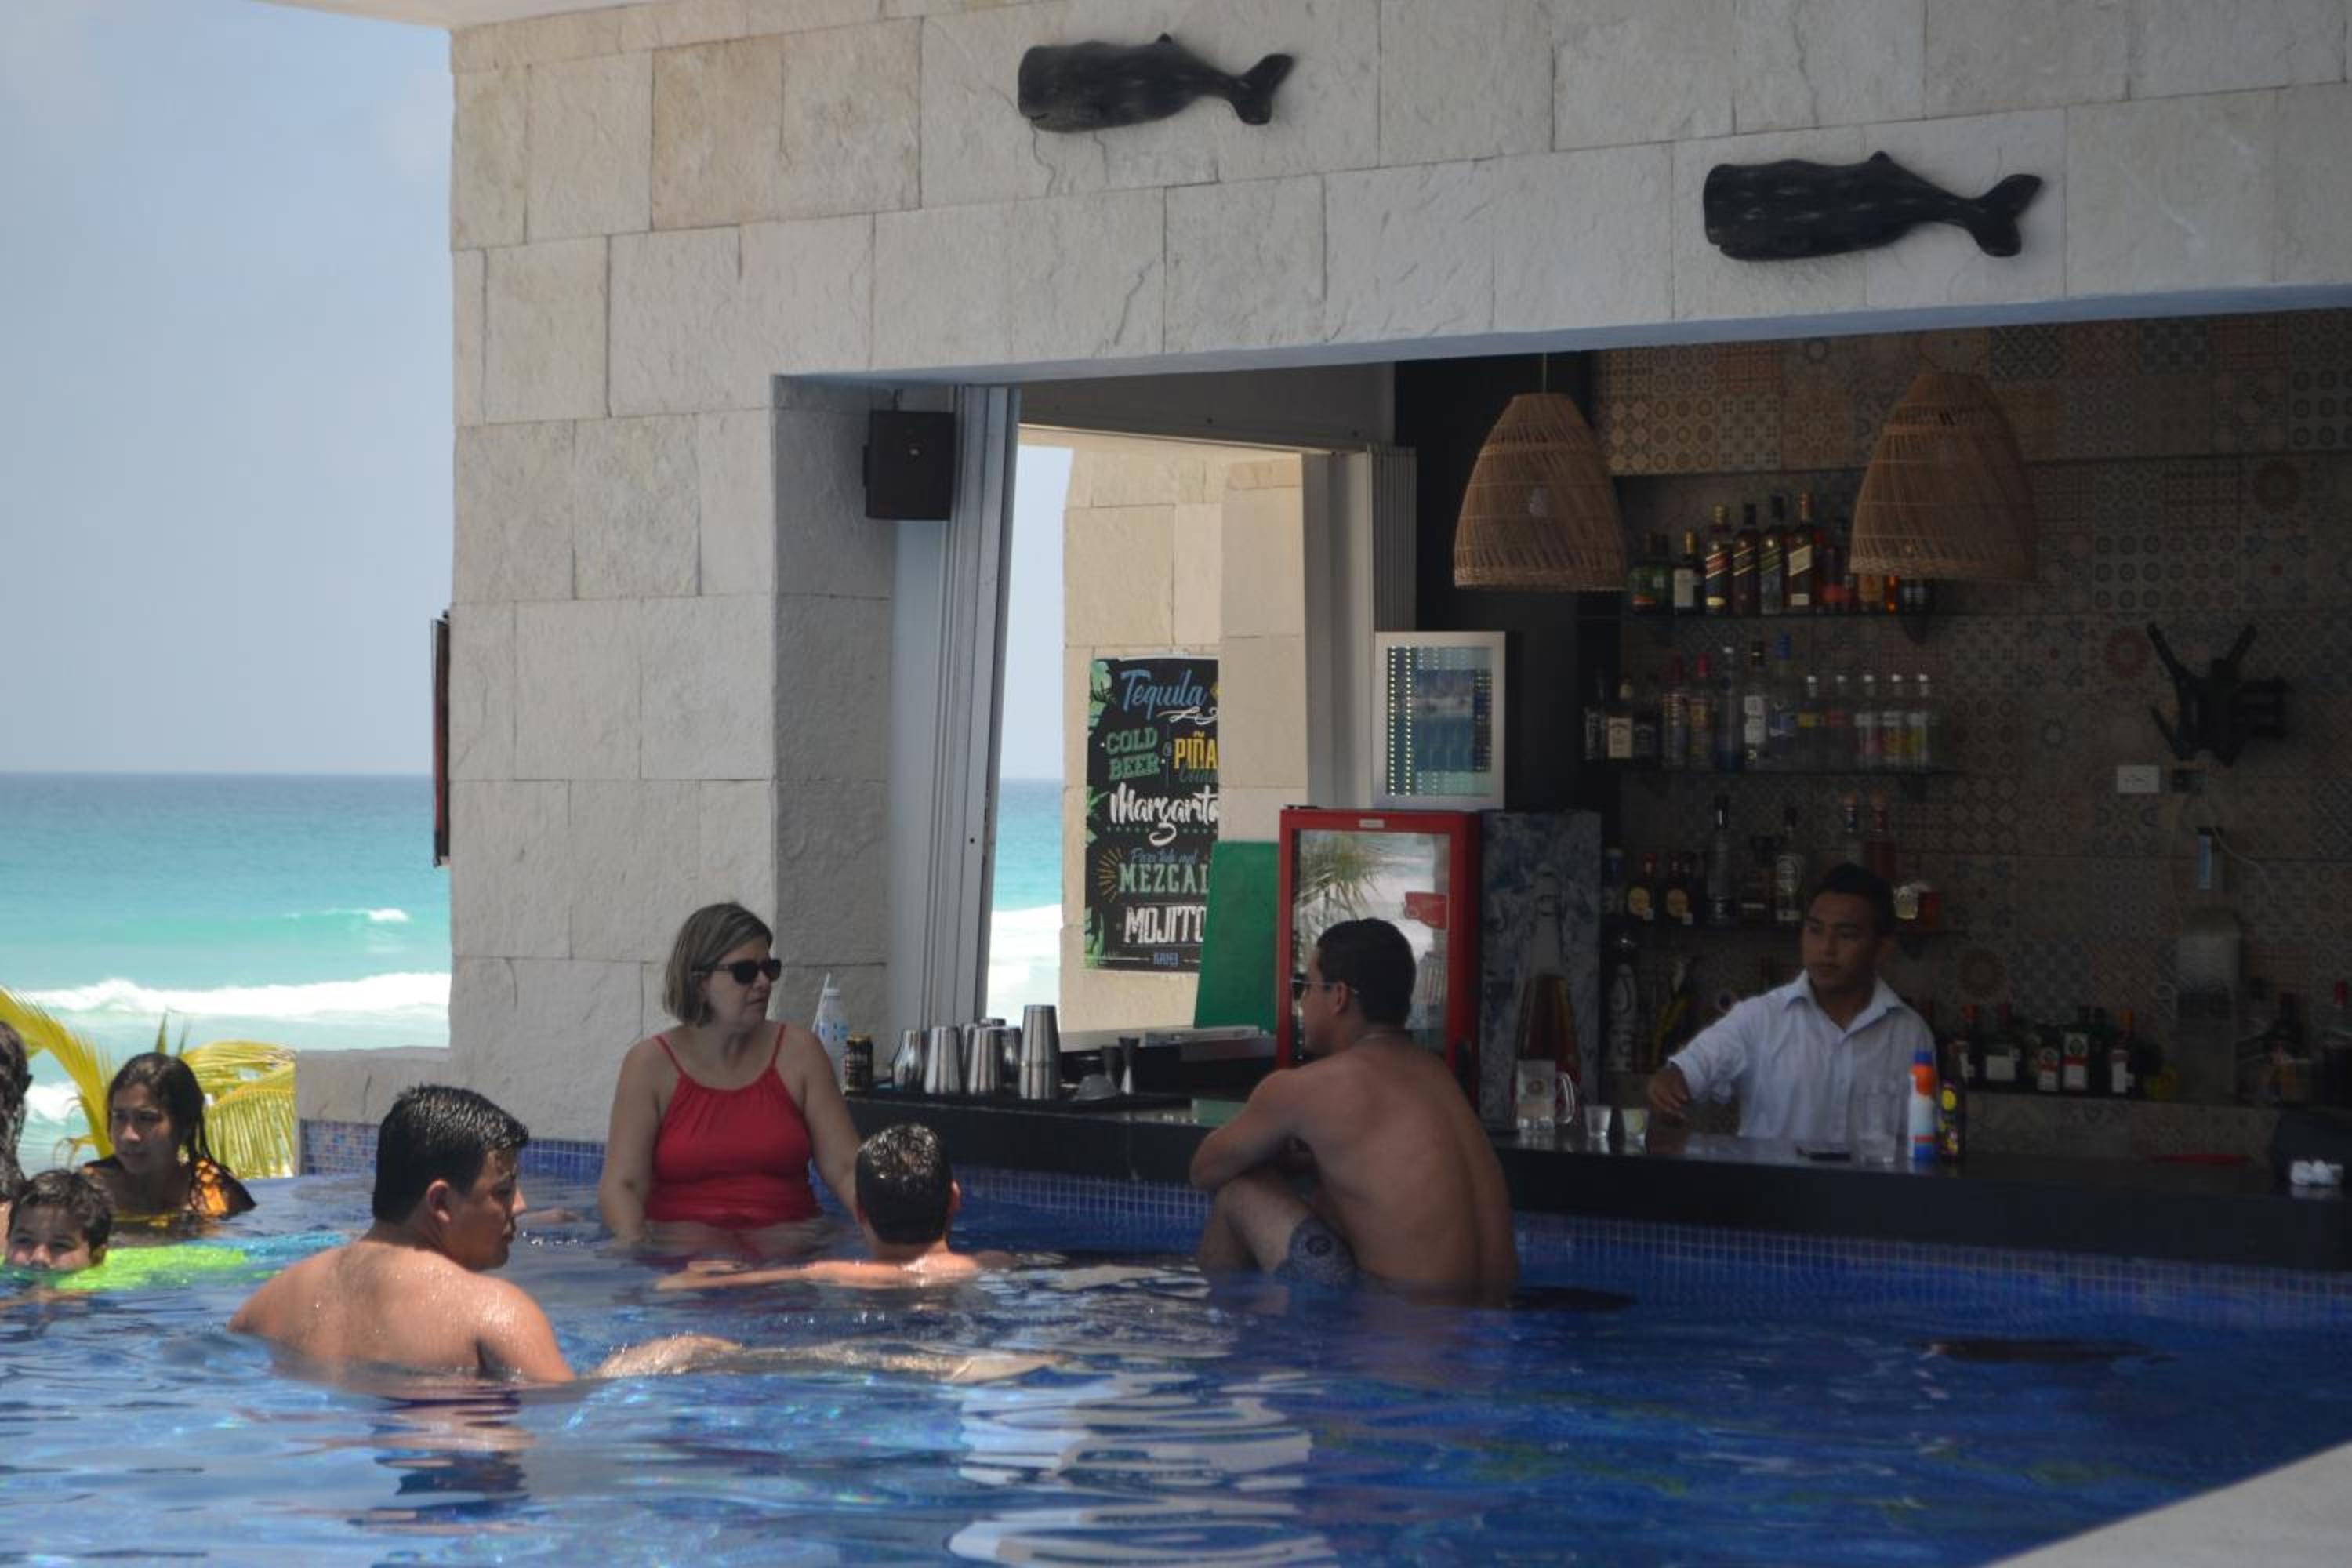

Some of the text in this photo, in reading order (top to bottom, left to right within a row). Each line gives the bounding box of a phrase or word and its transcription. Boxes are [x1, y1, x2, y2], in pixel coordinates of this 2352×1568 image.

[1120, 668, 1208, 721] Tequila
[1106, 727, 1159, 755] COLD
[1173, 730, 1218, 770] PIÑA
[1108, 752, 1161, 781] BEER
